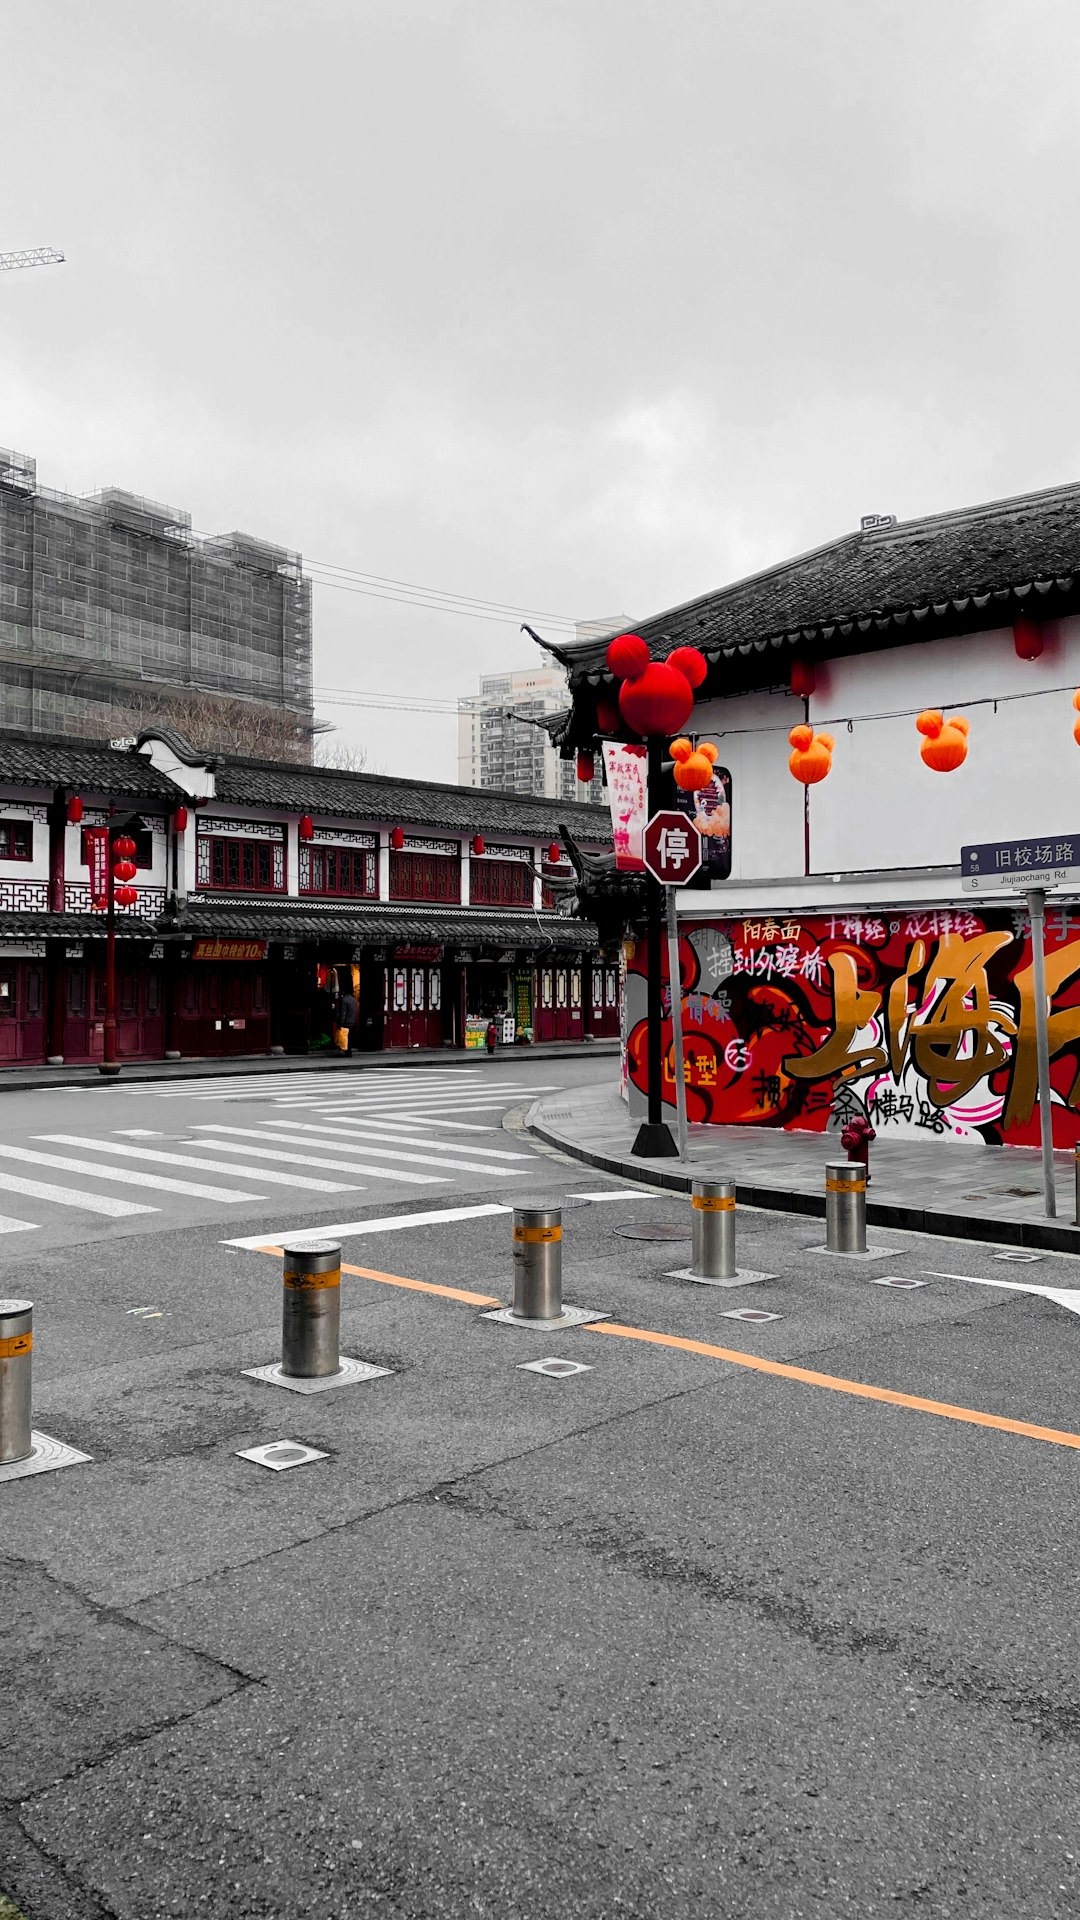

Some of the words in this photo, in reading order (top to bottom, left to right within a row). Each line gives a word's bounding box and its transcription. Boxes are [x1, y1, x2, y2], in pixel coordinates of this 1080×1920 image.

[656, 828, 690, 870] 停
[995, 842, 1074, 868] 旧校场路
[971, 878, 979, 888] S
[1000, 872, 1050, 886] Jiujiaochang
[742, 917, 801, 944] 阳春面
[706, 943, 826, 987] 摇到外婆桥
[515, 975, 532, 983] Shop
